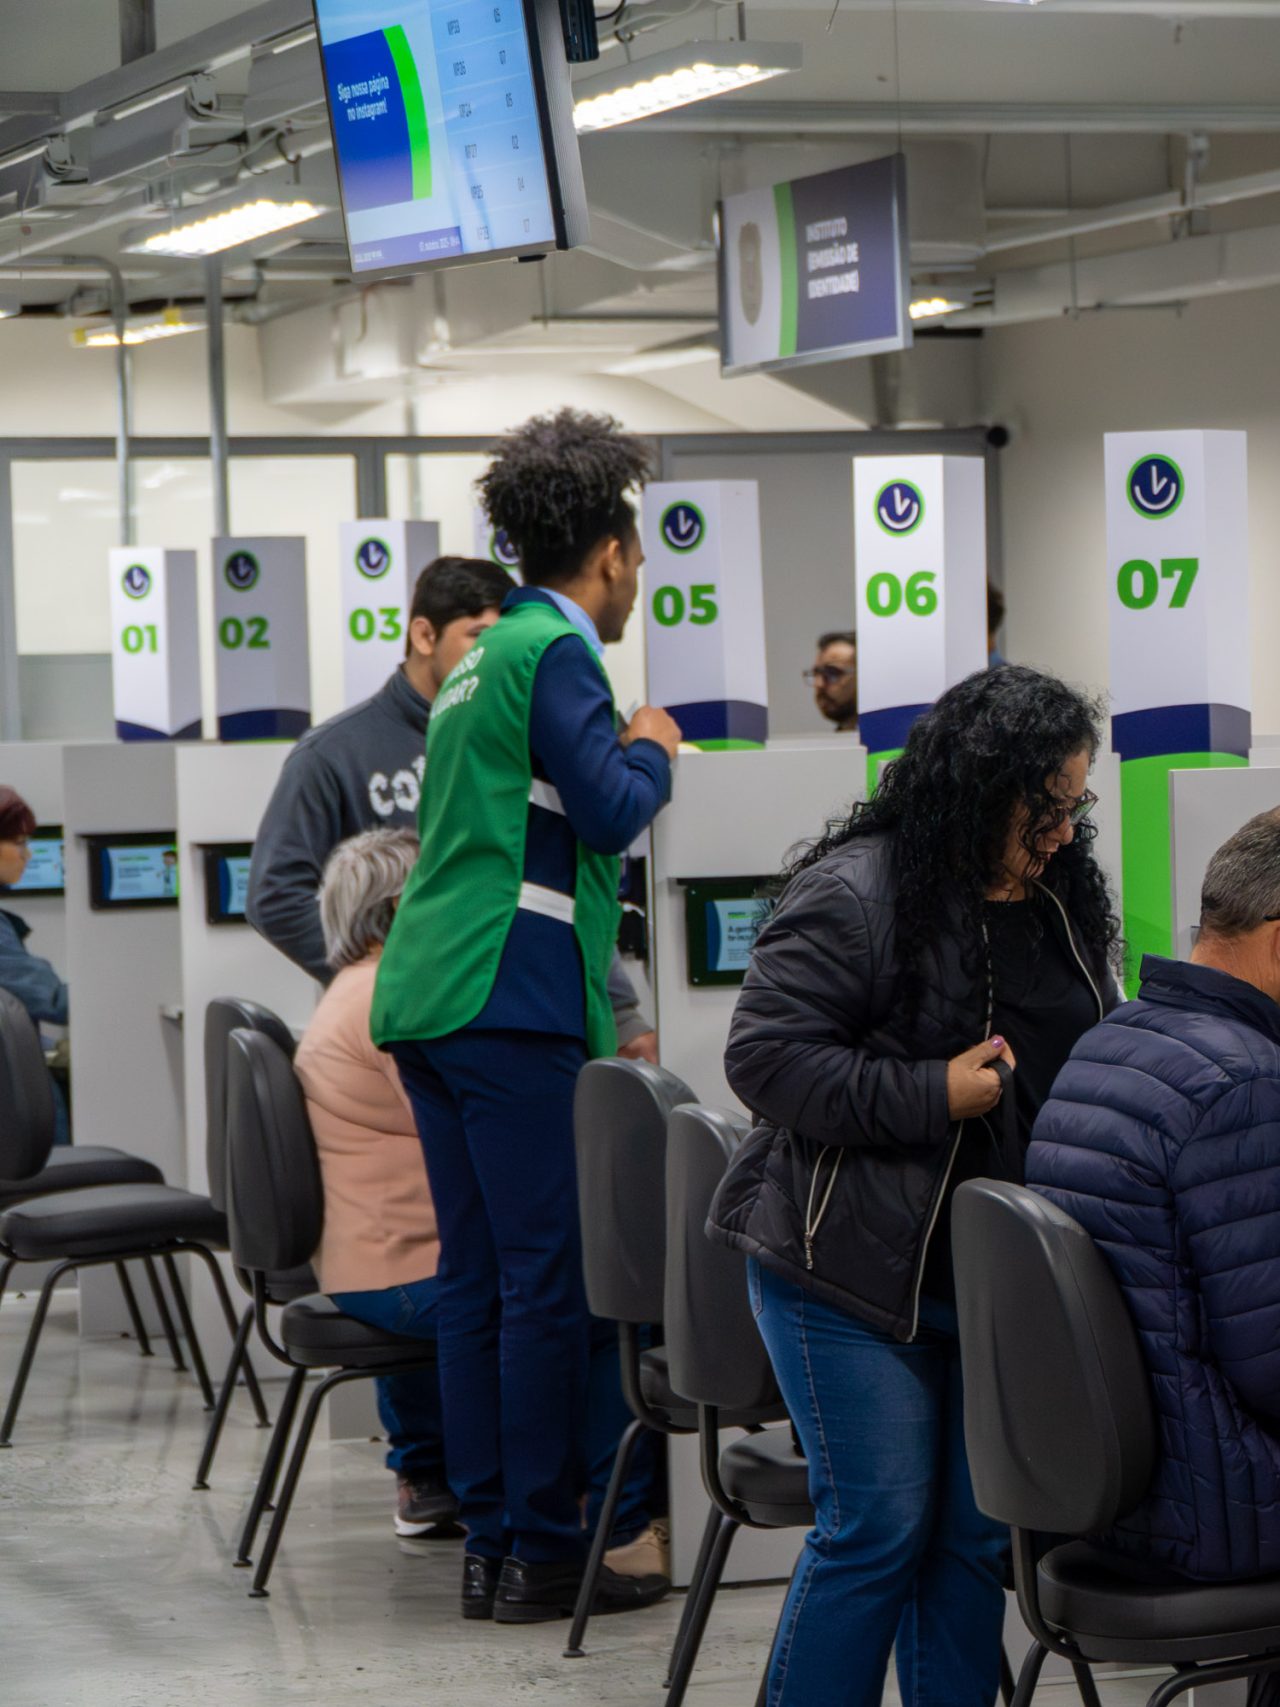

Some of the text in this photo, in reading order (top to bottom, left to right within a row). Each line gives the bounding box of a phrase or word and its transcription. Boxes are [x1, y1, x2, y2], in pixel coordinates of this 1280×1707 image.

[337, 72, 390, 104] Siga nossa página
[347, 107, 356, 122] no
[806, 216, 848, 243] INSTITUTO
[846, 242, 859, 264] DE
[866, 571, 938, 617] 06
[1117, 558, 1199, 610] 07
[652, 584, 718, 627] 05
[121, 623, 158, 654] 01
[218, 615, 270, 650] 02
[348, 607, 402, 642] 03
